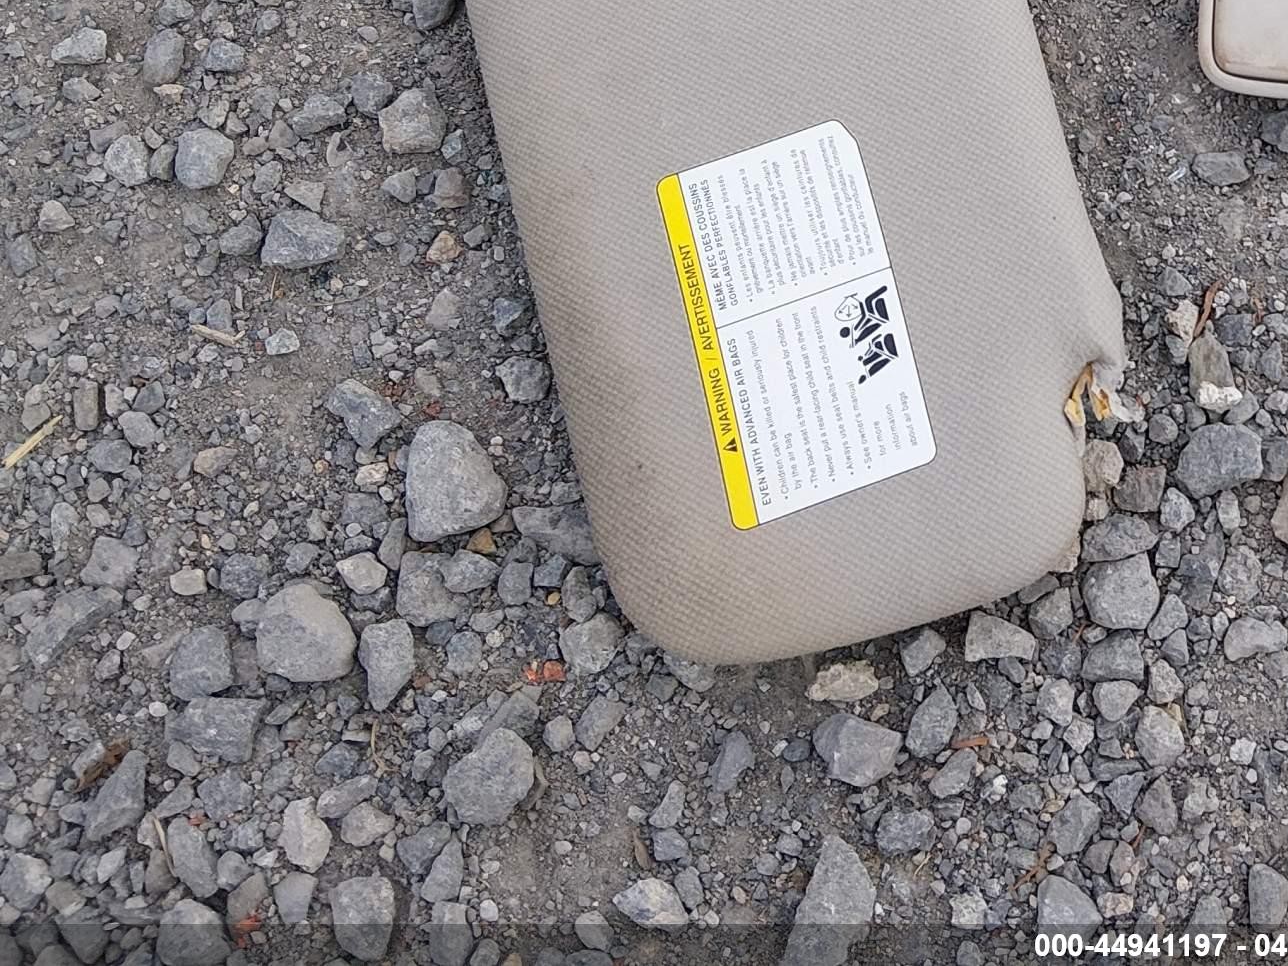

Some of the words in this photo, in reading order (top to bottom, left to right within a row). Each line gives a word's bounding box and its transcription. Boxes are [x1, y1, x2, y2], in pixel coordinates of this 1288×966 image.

[688, 184, 707, 231] COUSSINS
[700, 180, 724, 248] PERFECTIONNÉS
[701, 233, 713, 252] DES
[706, 255, 720, 278] AVEC
[718, 250, 738, 306] GONFLABLES
[678, 243, 714, 350] AVERTISSEMENT
[713, 282, 727, 310] MÊME
[792, 313, 801, 330] front
[810, 306, 824, 343] restraints
[775, 318, 788, 347] children
[797, 331, 805, 343] the
[727, 338, 741, 366] BAGS
[746, 330, 759, 358] injured
[782, 349, 790, 359] for
[800, 344, 806, 352] in
[802, 353, 811, 369] seat
[818, 345, 829, 364] child
[734, 369, 746, 385] AIR
[753, 360, 767, 394] seriously
[786, 360, 797, 380] place
[805, 370, 816, 388] child
[824, 366, 833, 380] and
[709, 368, 732, 436] WARNING
[790, 382, 800, 405] safest
[829, 382, 838, 403] belts
[846, 381, 859, 411] manual
[899, 392, 909, 412] bags
[739, 390, 758, 444] ADVANCED
[764, 406, 774, 428] killed
[796, 406, 804, 420] the
[811, 390, 825, 430] rear-facing
[833, 404, 842, 422] seat
[800, 420, 806, 428] is
[838, 424, 846, 439] use
[855, 413, 868, 444] owner's
[874, 421, 883, 442] more
[885, 404, 901, 450] information
[769, 430, 777, 441] be
[784, 433, 792, 450] bag
[800, 428, 810, 445] seat
[906, 424, 918, 446] about
[772, 442, 781, 457] can
[822, 439, 832, 452] put
[842, 441, 856, 469] Always
[863, 447, 872, 464] See
[878, 445, 886, 456] for
[752, 448, 764, 476] WITH
[804, 447, 815, 466] back
[825, 454, 836, 477] Never
[776, 459, 789, 494] Children
[791, 464, 799, 478] the
[810, 467, 818, 484] The
[758, 476, 772, 506] EVEN
[794, 480, 802, 490] by
